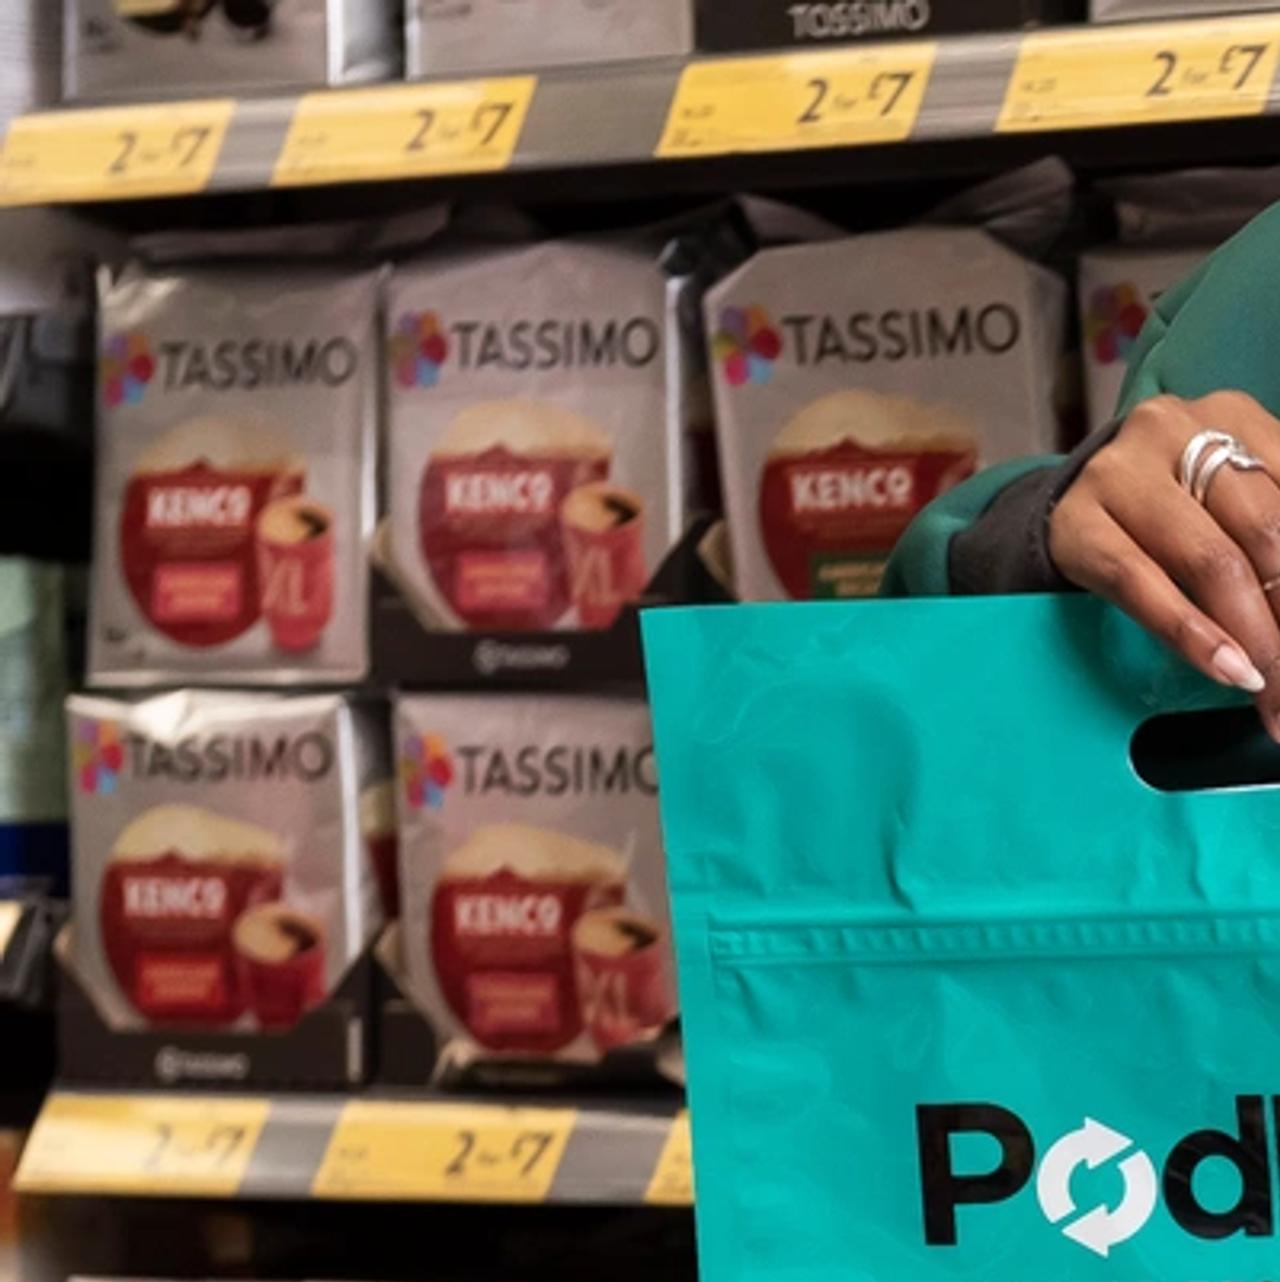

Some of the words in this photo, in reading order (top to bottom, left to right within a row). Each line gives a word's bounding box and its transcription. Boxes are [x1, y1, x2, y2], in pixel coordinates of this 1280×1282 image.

[1146, 50, 1178, 96] 2
[797, 77, 828, 124] 2
[450, 316, 660, 370] TASSIMO
[782, 303, 1019, 365] TASSIMO
[159, 336, 358, 389] TASSIMO
[147, 487, 250, 526] KENCO
[447, 473, 553, 513] KENCO
[791, 468, 912, 508] KENCO
[127, 734, 334, 782] TASSIMO
[123, 878, 226, 917] KENCO
[454, 895, 561, 937] KENCO
